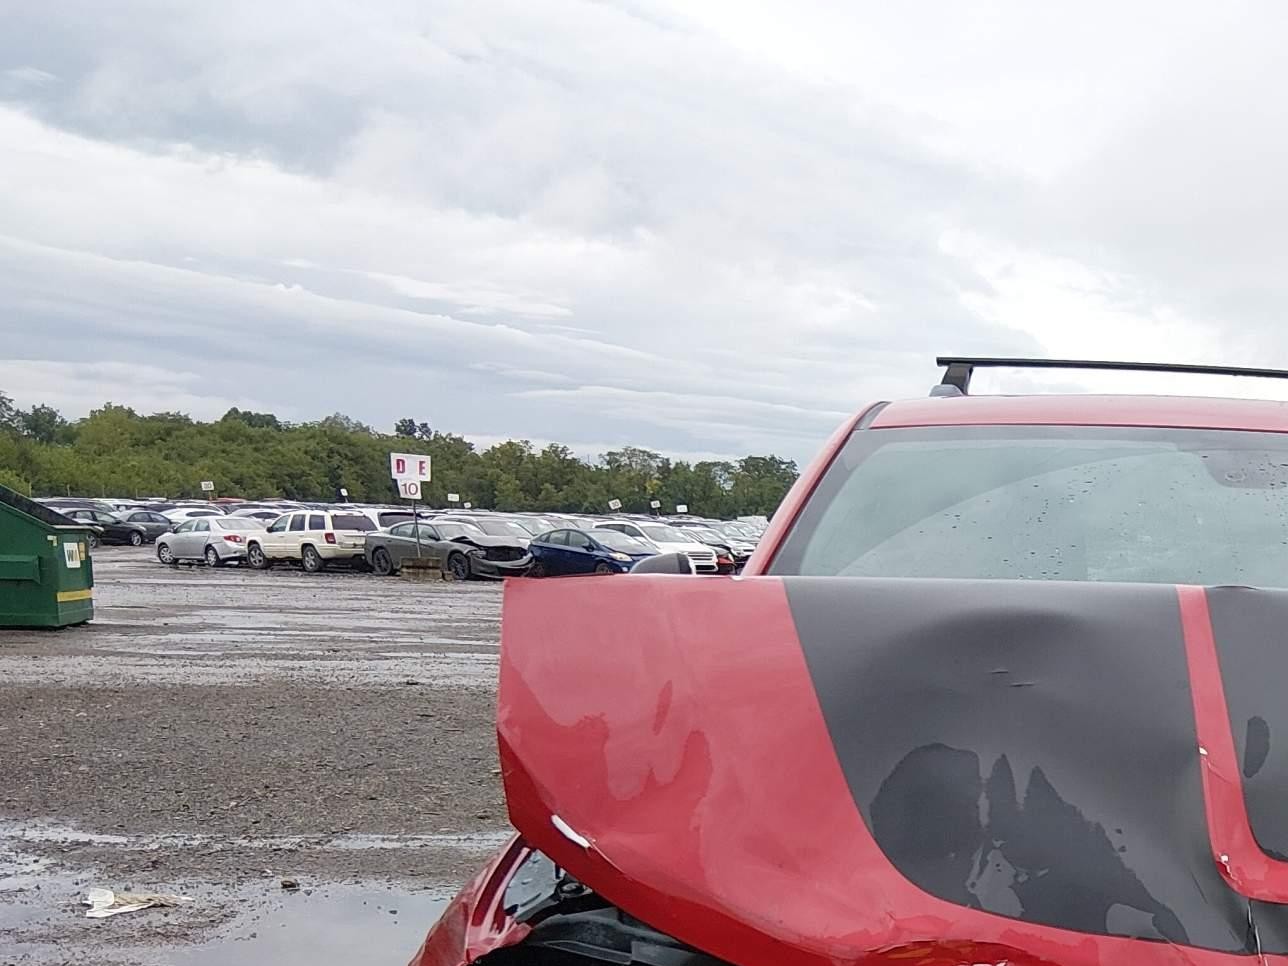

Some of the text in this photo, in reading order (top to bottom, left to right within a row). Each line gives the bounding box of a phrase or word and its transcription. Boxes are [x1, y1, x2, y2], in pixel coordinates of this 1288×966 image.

[396, 459, 426, 475] D E
[401, 482, 419, 496] 10
